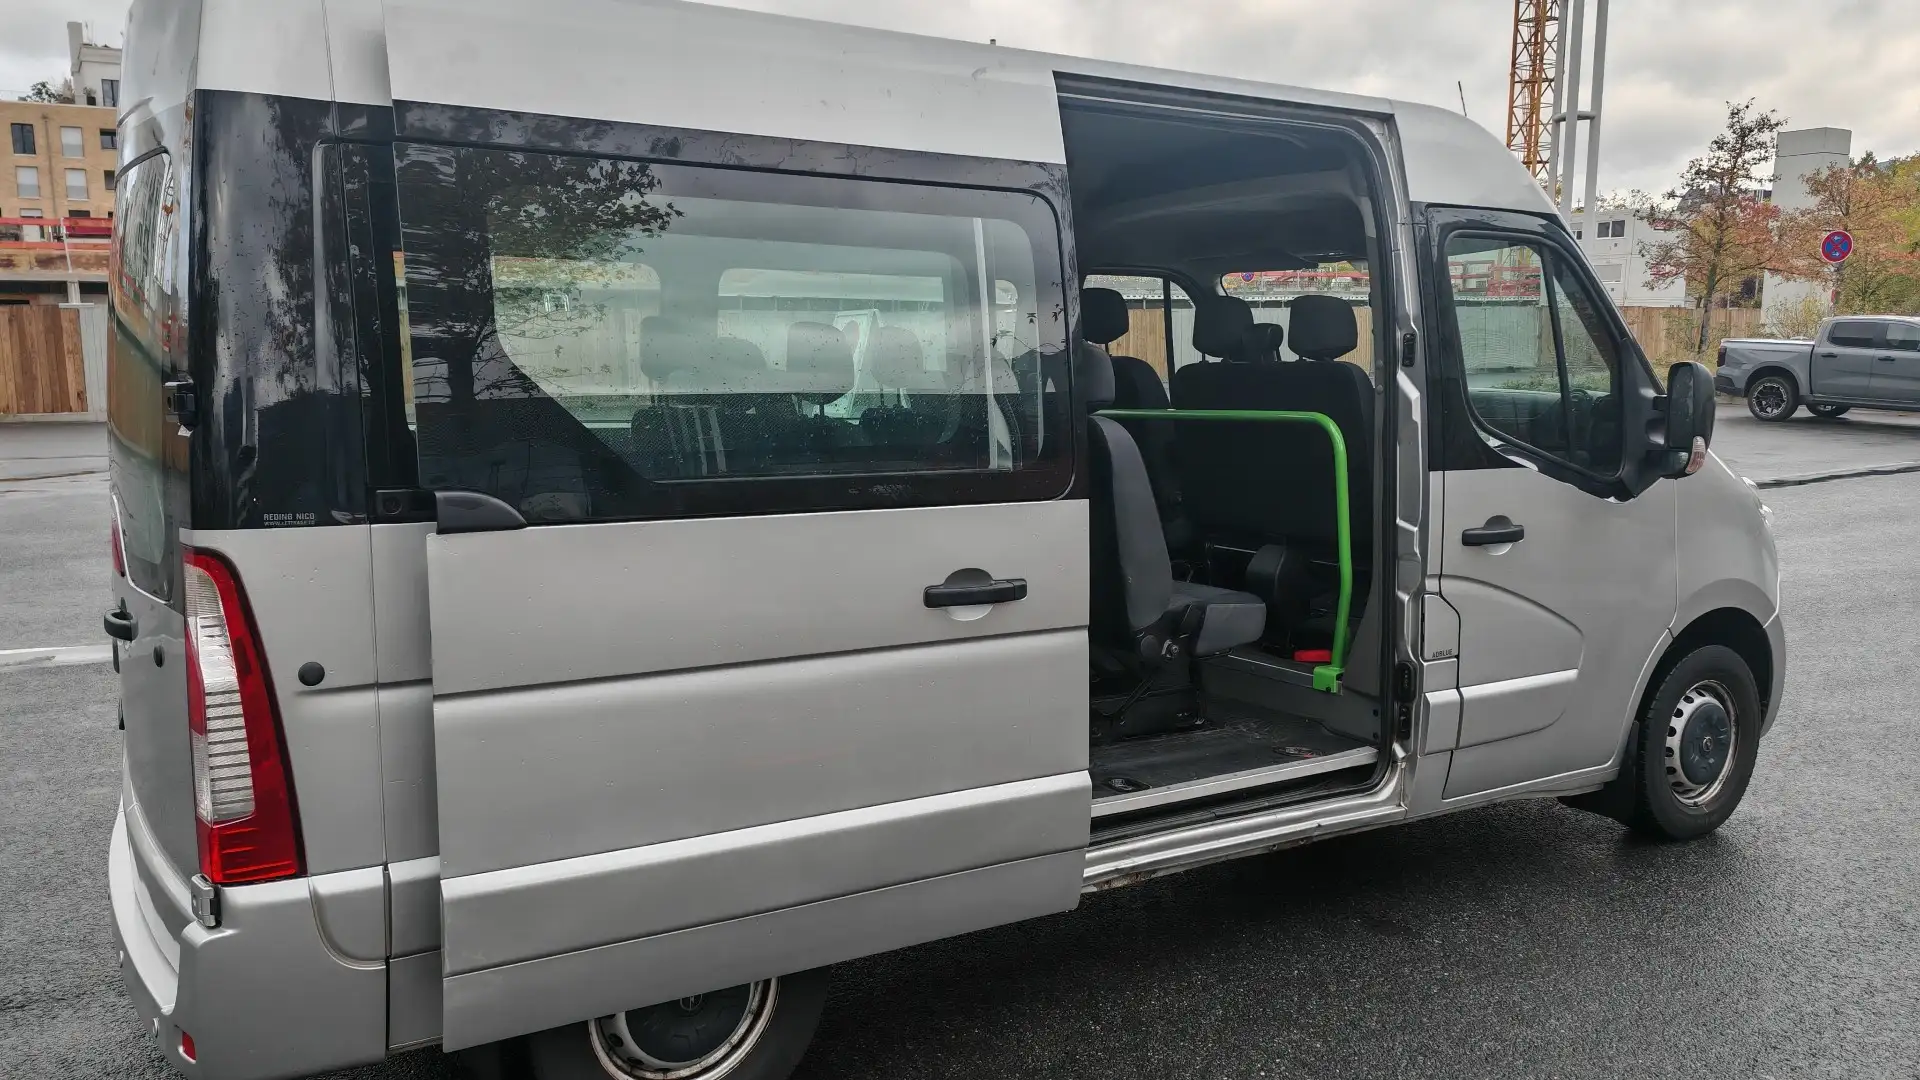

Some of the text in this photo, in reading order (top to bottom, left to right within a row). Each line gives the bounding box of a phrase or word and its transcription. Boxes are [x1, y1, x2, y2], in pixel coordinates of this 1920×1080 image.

[263, 512, 315, 521] REDING NICO
[1432, 648, 1453, 658] ADBLUE
